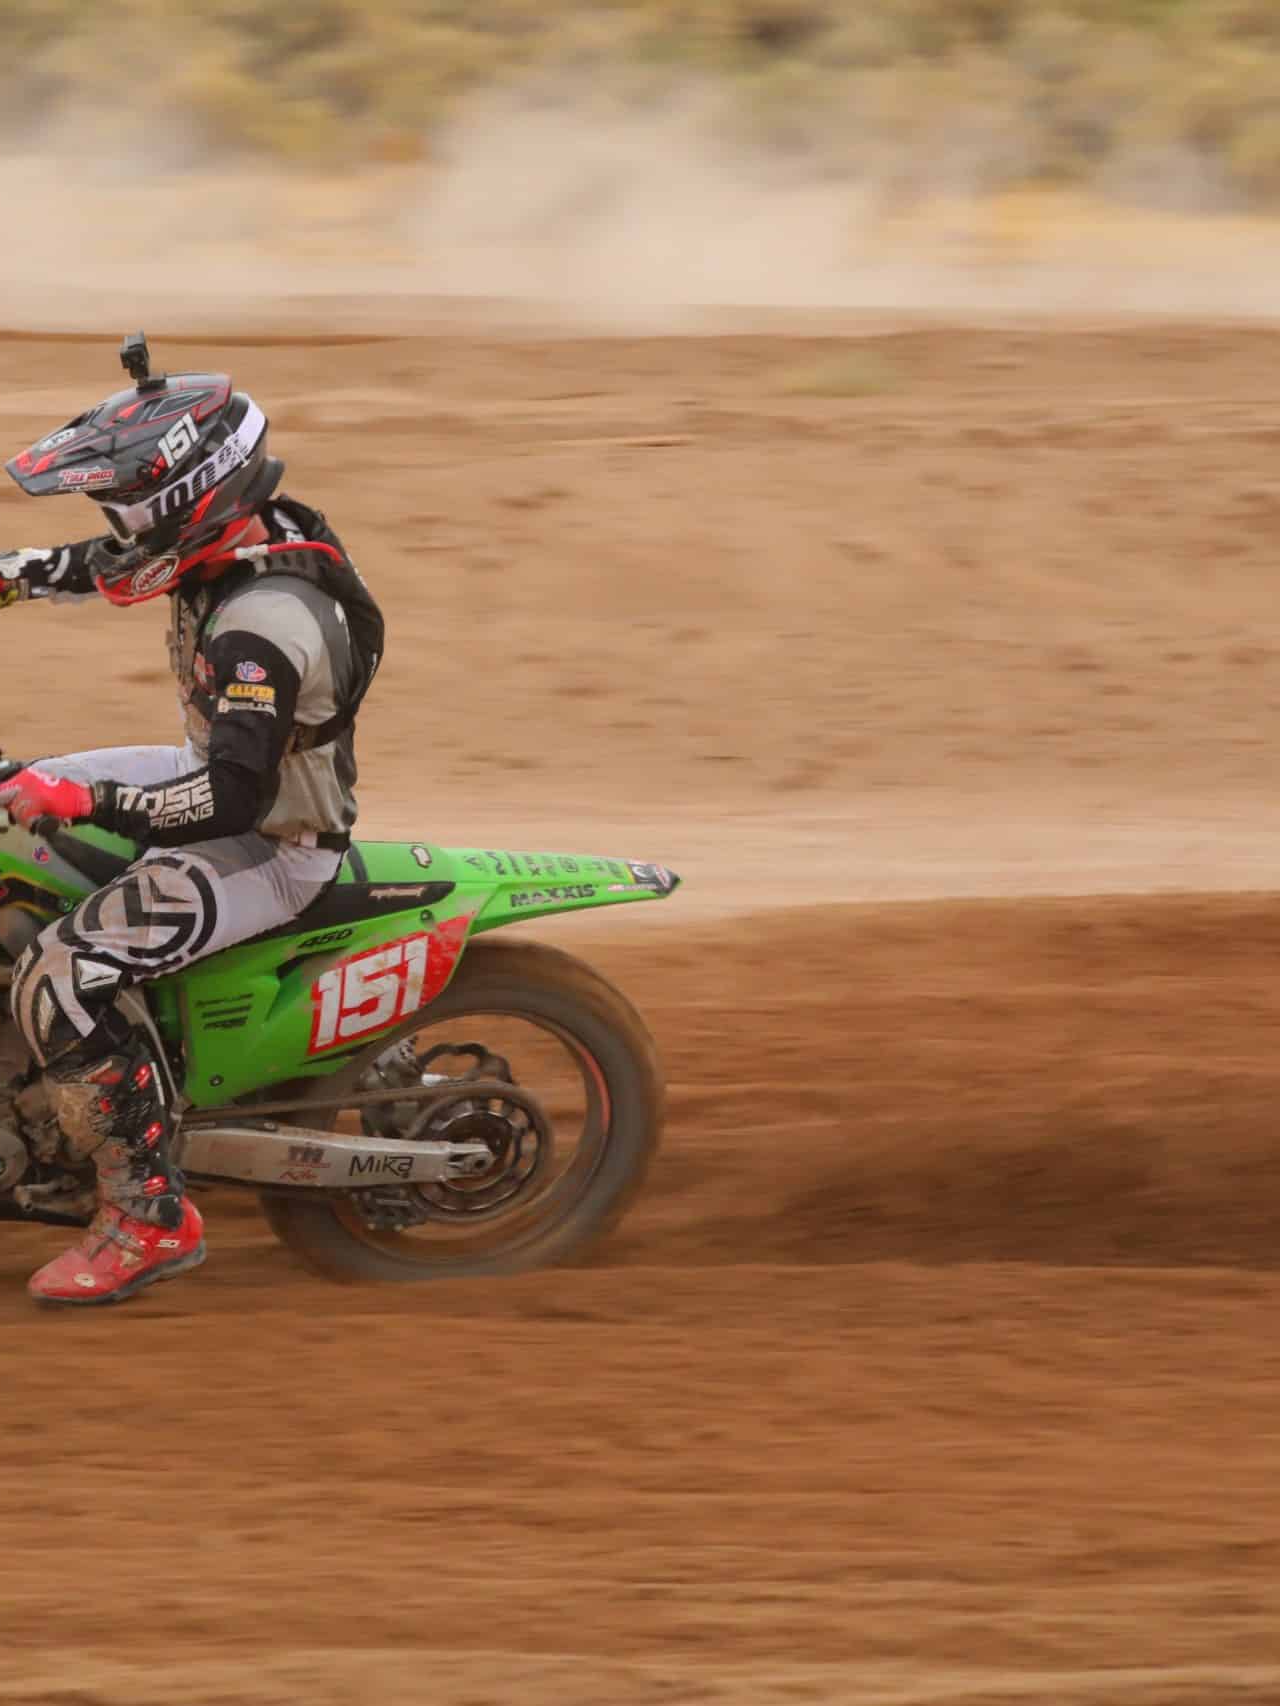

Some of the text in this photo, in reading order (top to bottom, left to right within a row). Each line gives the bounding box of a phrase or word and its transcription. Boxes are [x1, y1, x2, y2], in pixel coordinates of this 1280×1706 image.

[158, 412, 200, 469] 151
[511, 884, 596, 907] MAXXIS
[315, 935, 429, 1049] 151
